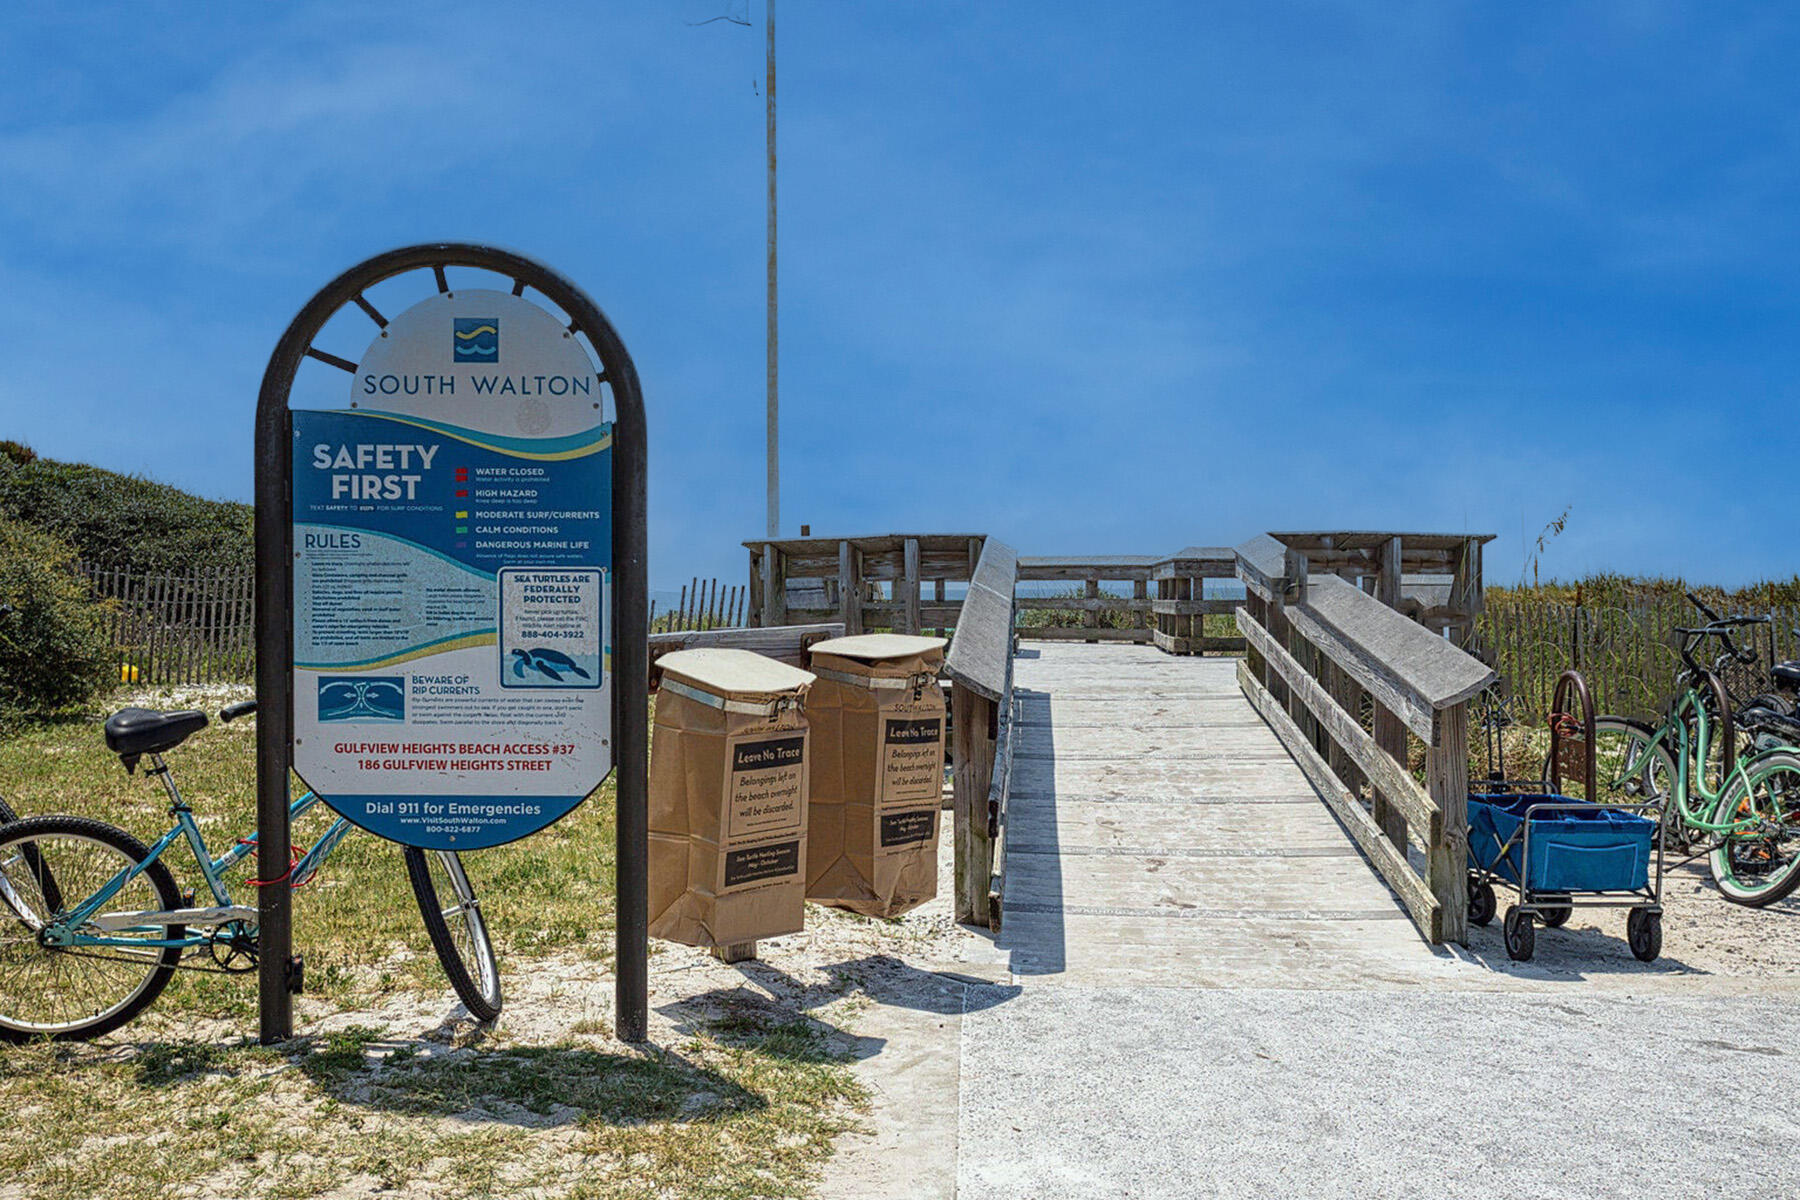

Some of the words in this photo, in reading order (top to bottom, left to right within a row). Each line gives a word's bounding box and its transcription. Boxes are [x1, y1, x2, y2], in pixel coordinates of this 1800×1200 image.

[364, 375, 455, 396] SOUTH
[472, 375, 590, 396] WALTON
[312, 444, 440, 470] SAFETY
[476, 468, 507, 476] WATER
[509, 468, 544, 476] CLOSED
[332, 475, 422, 500] FIRST
[527, 511, 600, 520] SURF/CURRENTS
[476, 526, 501, 534] CALM
[503, 526, 559, 534] CONDITIONS
[305, 534, 361, 549] RULES
[514, 575, 530, 583] SEA
[532, 575, 570, 583] TURTLES
[572, 575, 590, 583] ARE
[522, 631, 584, 639] 888-404-3922
[412, 676, 453, 684] BEWARE
[454, 676, 469, 684] OF
[412, 686, 427, 694] RIP
[429, 686, 480, 694] CURRENTS
[920, 726, 939, 737] Trace
[334, 743, 400, 755] GULFVIEW
[402, 743, 456, 755] HEIGHTS
[458, 743, 501, 755] BEACH
[503, 743, 550, 755] ACCESS
[552, 744, 575, 755] #37
[738, 752, 762, 764] Leave
[762, 750, 775, 760] No
[776, 748, 800, 759] Trace
[358, 760, 380, 771] 186
[383, 760, 448, 771] GULFVIEW
[450, 760, 504, 771] HEIGHTS
[508, 760, 552, 771] STREET
[888, 764, 899, 773] the
[740, 775, 777, 787] Belongings
[778, 772, 788, 782] left
[902, 777, 909, 785] be
[736, 793, 747, 802] the
[748, 790, 769, 801] beach
[770, 786, 798, 798] overnight
[366, 803, 394, 815] Dial
[400, 803, 419, 815] 911
[424, 803, 445, 815] for
[448, 803, 541, 817] Emergencies
[740, 807, 752, 817] will
[753, 806, 762, 816] be
[763, 801, 794, 815] discarded.
[400, 817, 507, 825] www.VisitSouthWalton.com
